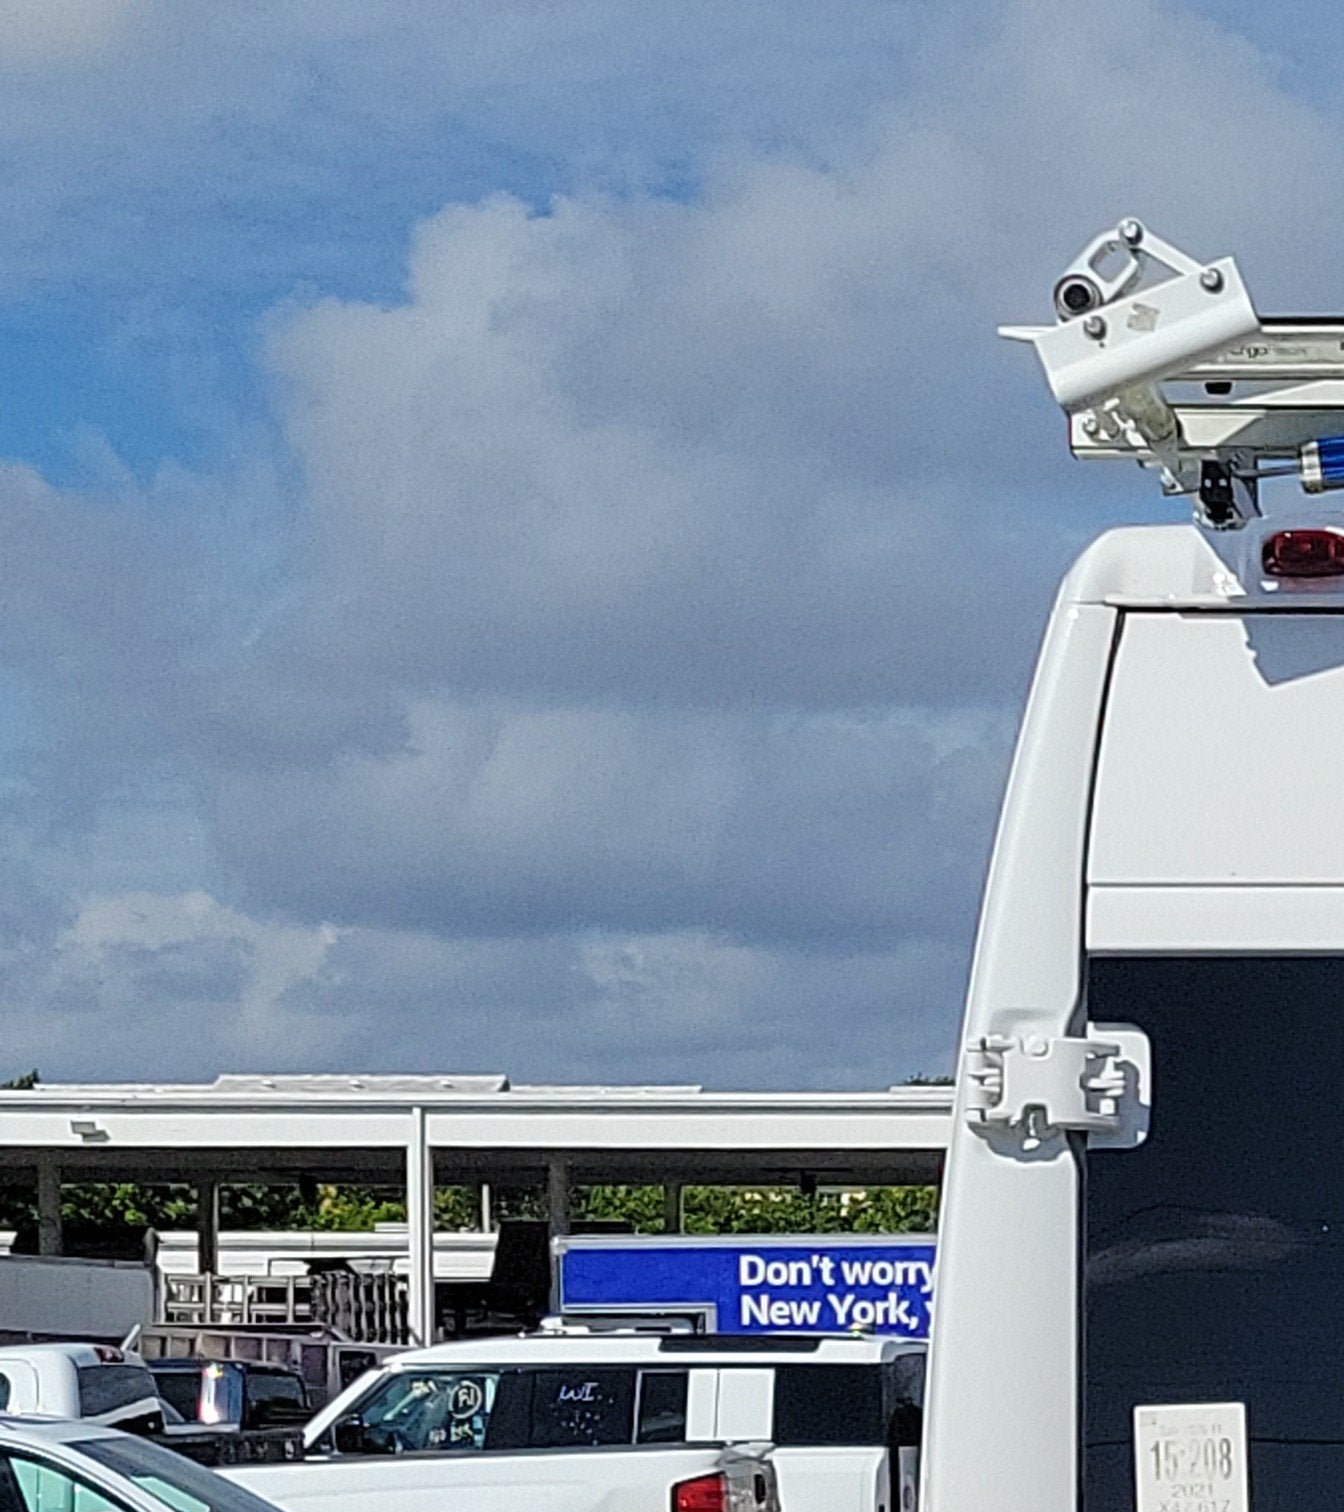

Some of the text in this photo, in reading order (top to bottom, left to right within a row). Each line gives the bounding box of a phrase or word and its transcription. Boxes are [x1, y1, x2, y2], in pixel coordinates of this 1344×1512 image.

[740, 1255, 932, 1293] Don't worry
[741, 1294, 821, 1326] New
[827, 1292, 919, 1330] York,
[1171, 1483, 1214, 1498] 2021
